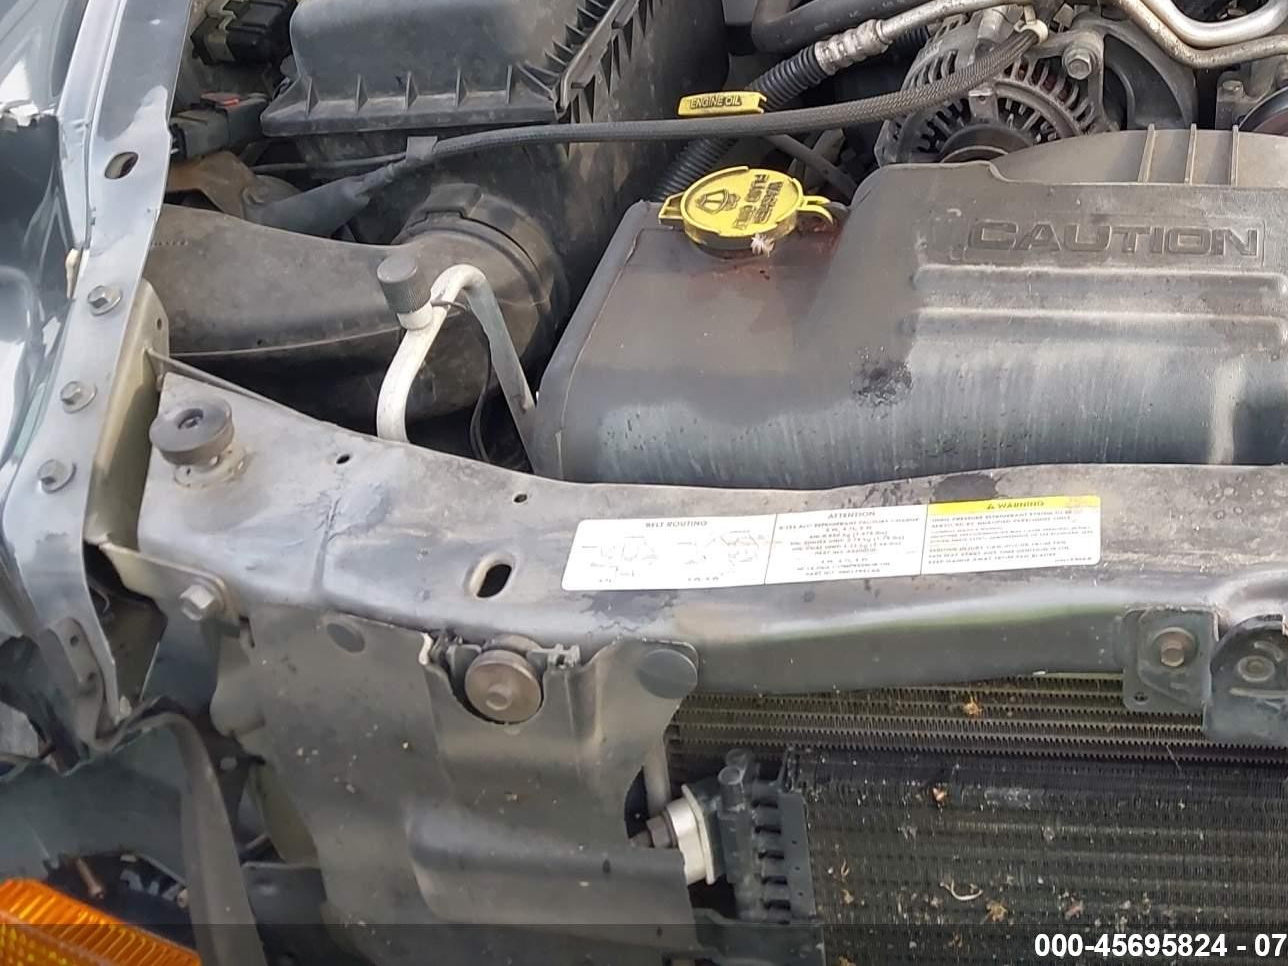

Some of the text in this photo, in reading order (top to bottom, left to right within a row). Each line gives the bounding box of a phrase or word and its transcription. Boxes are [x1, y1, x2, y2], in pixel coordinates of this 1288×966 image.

[689, 94, 742, 109] ENGINE OIL
[967, 219, 1260, 258] CAUTION
[998, 500, 1045, 509] WARNING
[828, 511, 876, 520] ATTENTION
[666, 520, 708, 528] ROUTING
